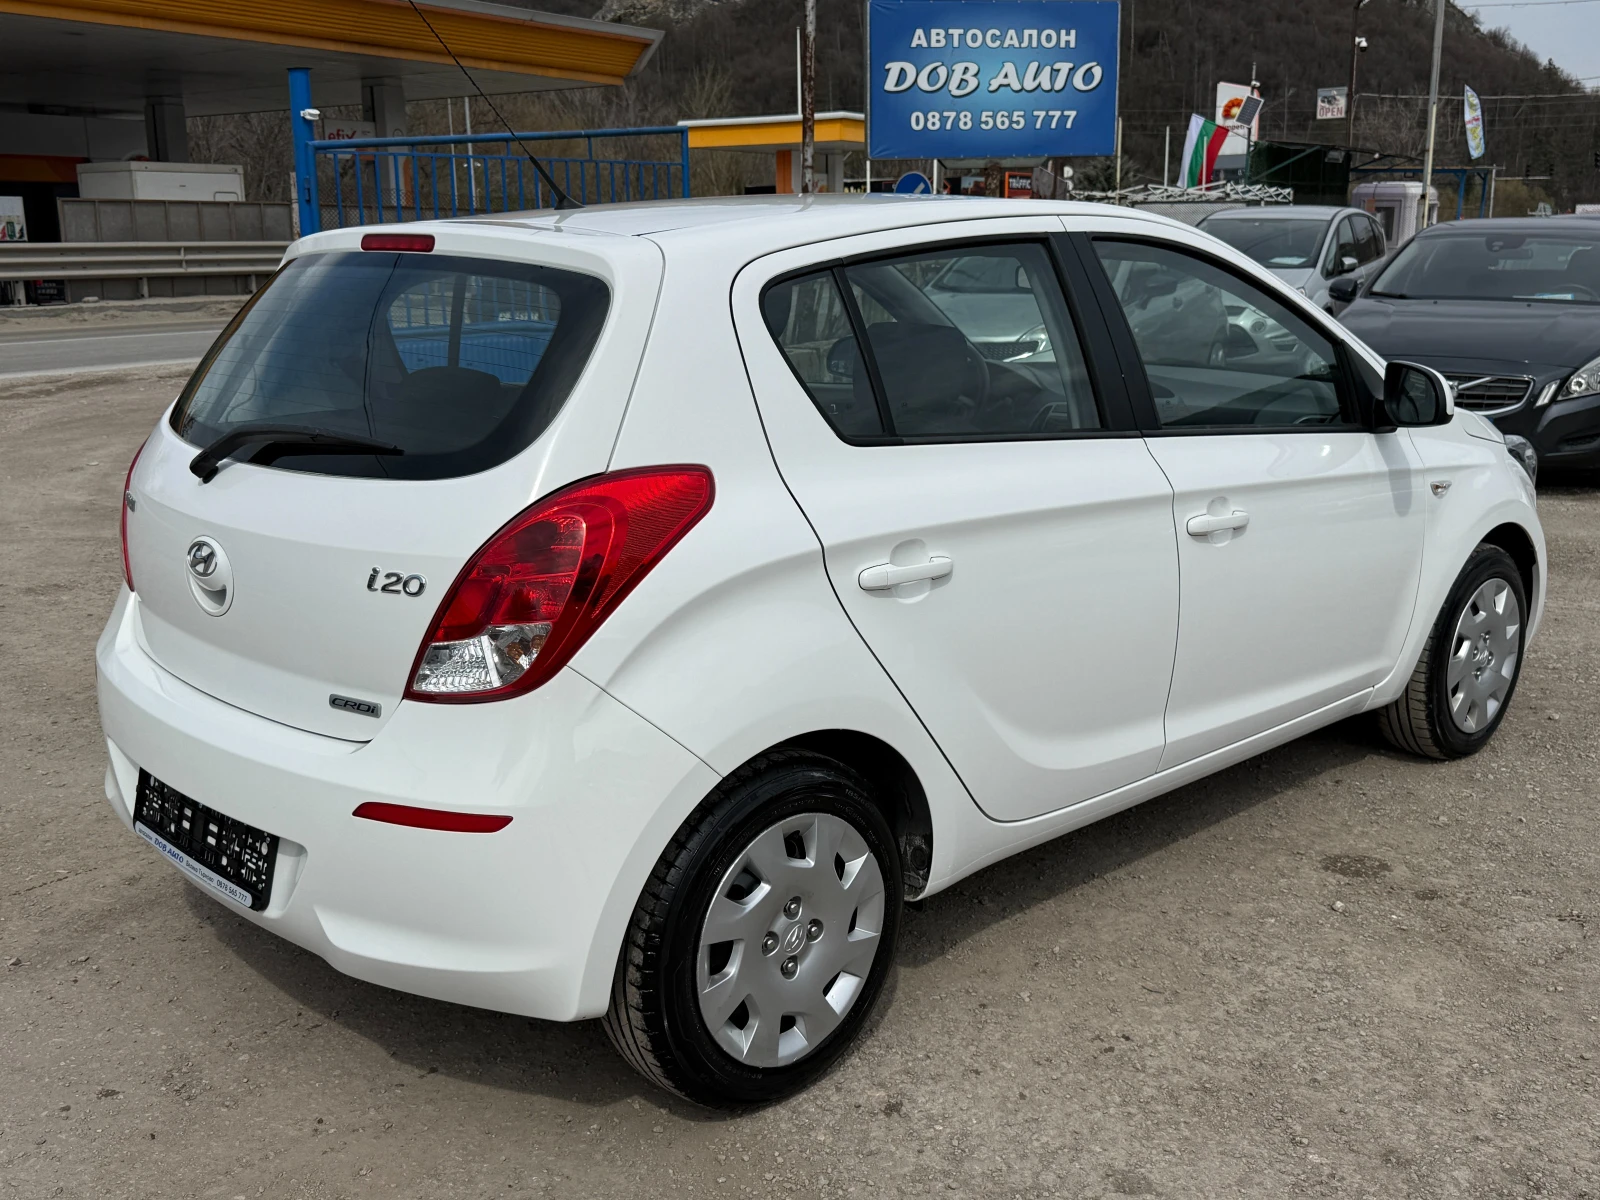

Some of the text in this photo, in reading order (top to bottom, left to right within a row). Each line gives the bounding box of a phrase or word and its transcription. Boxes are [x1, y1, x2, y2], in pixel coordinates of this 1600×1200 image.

[910, 28, 1077, 49] АВТОСАЛОН
[883, 61, 1103, 97] DOB AUTO
[910, 110, 1078, 131] 0878 565 777
[1318, 106, 1344, 117] OPEN
[366, 566, 428, 598] i20
[331, 697, 377, 714] CRDi
[154, 837, 168, 852] DOB
[216, 879, 229, 892] 0878
[228, 886, 238, 897] 565
[238, 891, 248, 903] 777
